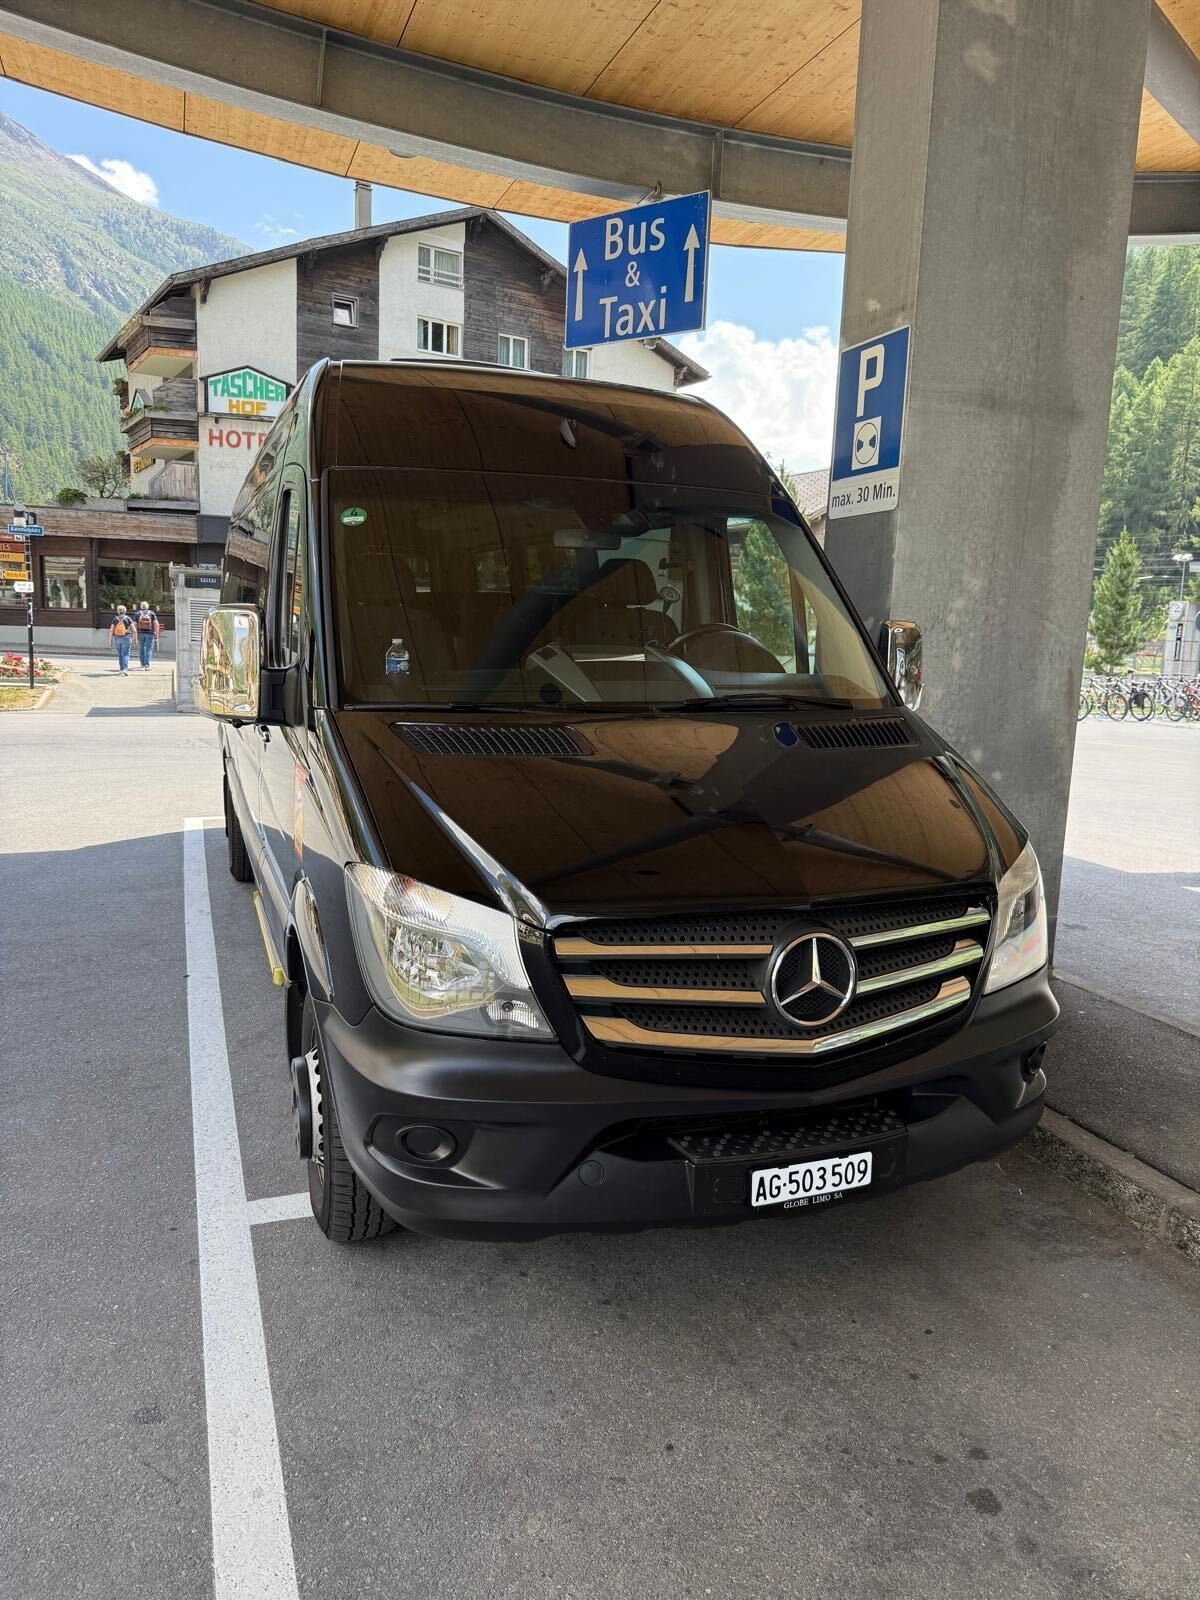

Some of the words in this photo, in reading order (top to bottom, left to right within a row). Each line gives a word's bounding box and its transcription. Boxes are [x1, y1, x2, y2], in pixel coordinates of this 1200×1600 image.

[604, 217, 666, 261] Bus
[625, 261, 640, 288] &
[599, 285, 667, 338] Taxi
[856, 343, 886, 418] P
[228, 399, 267, 416] HOF
[208, 428, 268, 450] HOTE
[831, 493, 854, 508] max.
[857, 486, 870, 504] 30
[872, 482, 896, 501] Min.
[783, 1198, 809, 1209] GLOBE
[812, 1194, 831, 1204] LIMO
[833, 1191, 843, 1199] SA
